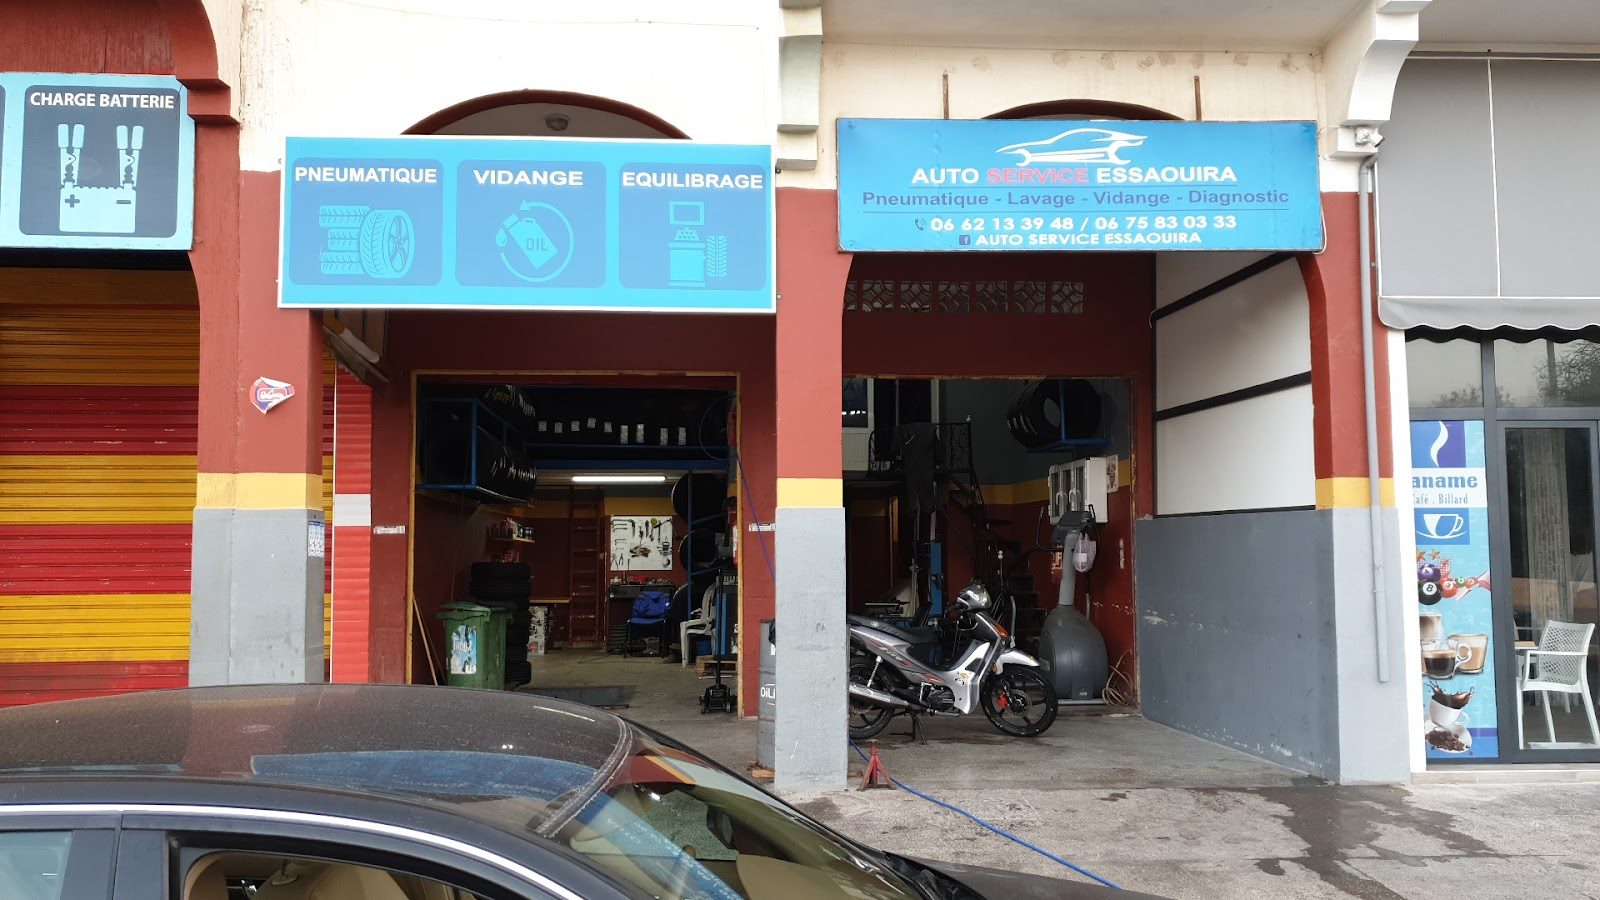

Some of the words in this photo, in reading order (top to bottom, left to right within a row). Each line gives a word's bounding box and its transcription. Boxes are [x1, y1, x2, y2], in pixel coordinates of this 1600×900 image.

[30, 92, 96, 107] CHARGE
[99, 94, 174, 109] BATTERIE
[294, 167, 438, 184] PNEUMATIQUE
[473, 169, 584, 186] VIDANGE
[622, 171, 764, 190] EQUILIBRAGE
[911, 168, 980, 184] AUTO
[986, 168, 1089, 184] SERVICE
[1096, 166, 1238, 183] ESSAOUIRA
[862, 192, 989, 208] Pneumatique
[1007, 192, 1075, 208] Lavage
[1093, 191, 1170, 207] Vidange
[1189, 190, 1289, 205] Diagnostic
[930, 217, 955, 231] 06
[961, 217, 985, 231] 62
[992, 217, 1015, 231] 13
[1021, 217, 1044, 231] 39
[1050, 216, 1074, 230] 48
[1080, 217, 1089, 231] /
[1095, 217, 1119, 230] 06
[1125, 216, 1148, 229] 75
[1154, 216, 1178, 229] 83
[1183, 215, 1207, 229] 03
[1213, 215, 1237, 228] 33
[526, 238, 548, 251] OIL
[975, 234, 1023, 246] AUTO
[1029, 233, 1099, 245] SERVICE
[1104, 232, 1202, 245] ESSAOUIRA
[1413, 492, 1429, 504] afé
[1438, 493, 1469, 504] Billard
